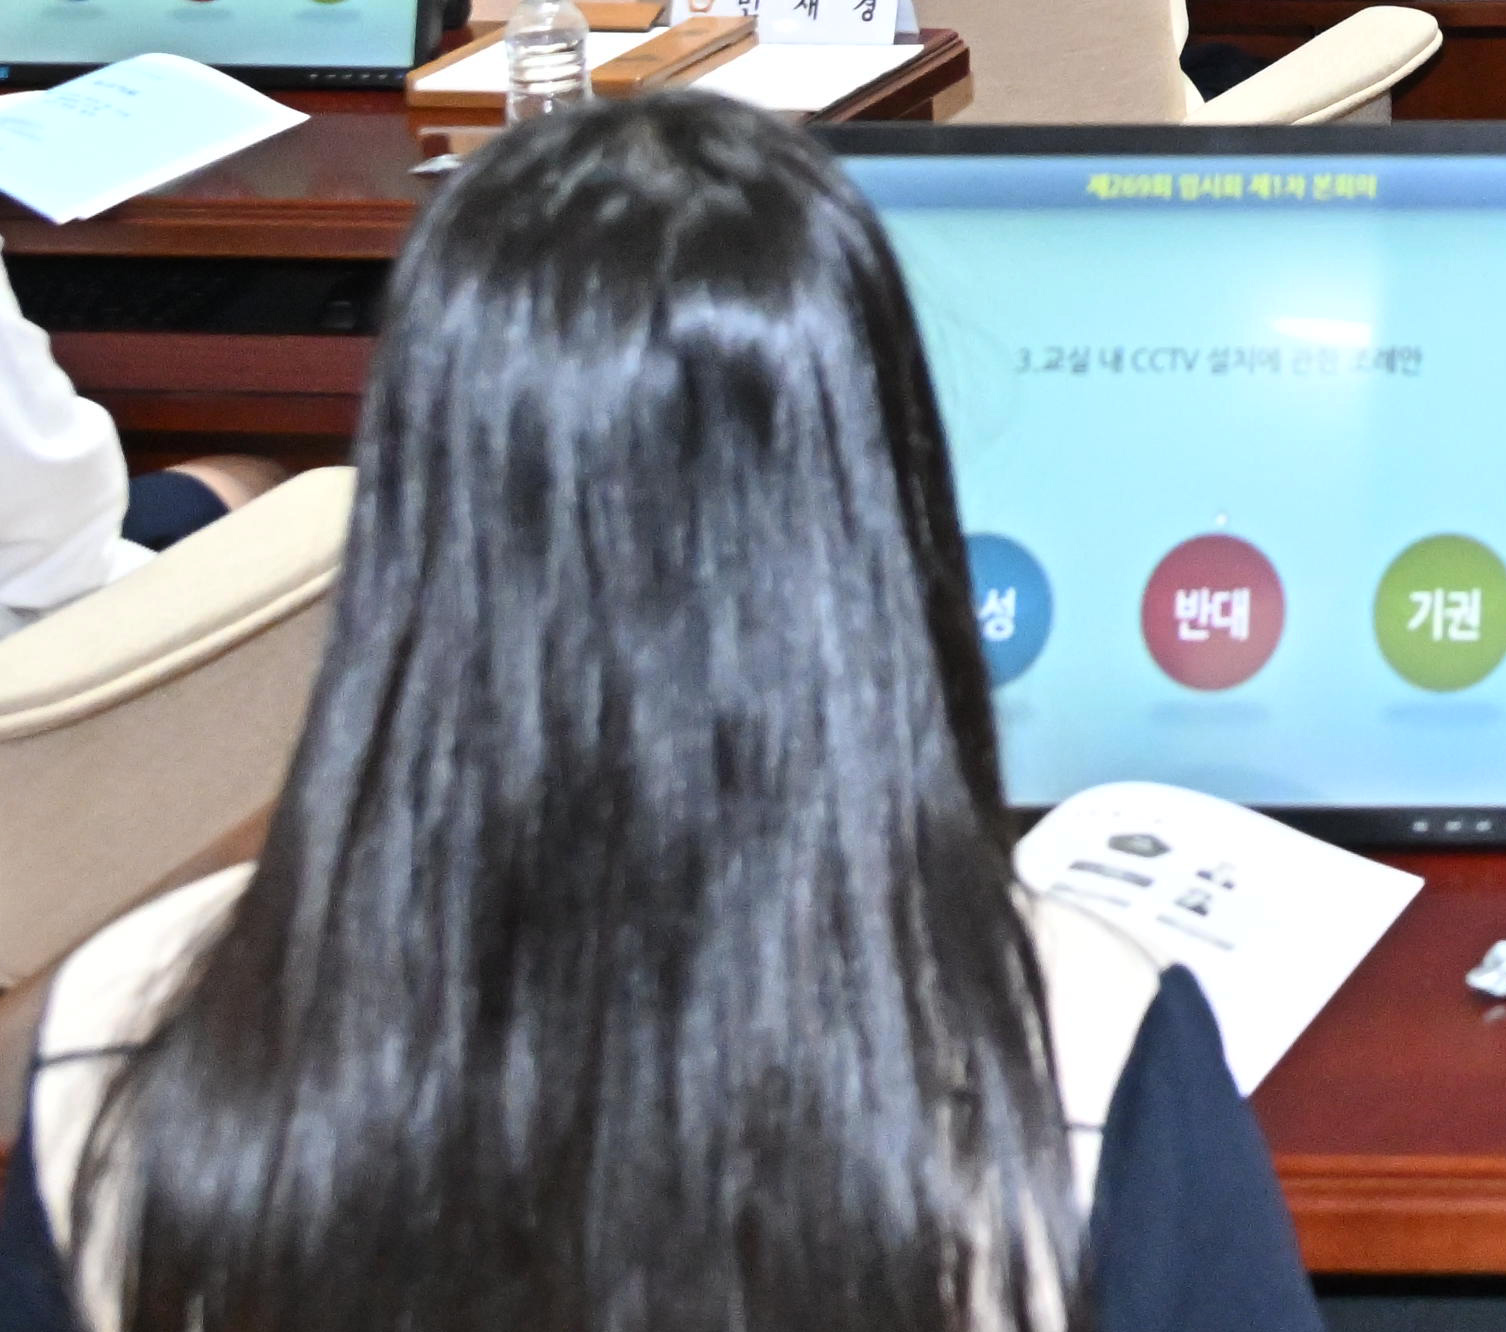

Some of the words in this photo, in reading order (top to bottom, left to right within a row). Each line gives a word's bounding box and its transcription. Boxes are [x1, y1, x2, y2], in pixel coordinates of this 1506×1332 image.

[1131, 346, 1200, 374] CCTV
[979, 587, 1018, 640] 성
[1173, 587, 1252, 642] 반대
[1406, 587, 1482, 643] 기권
